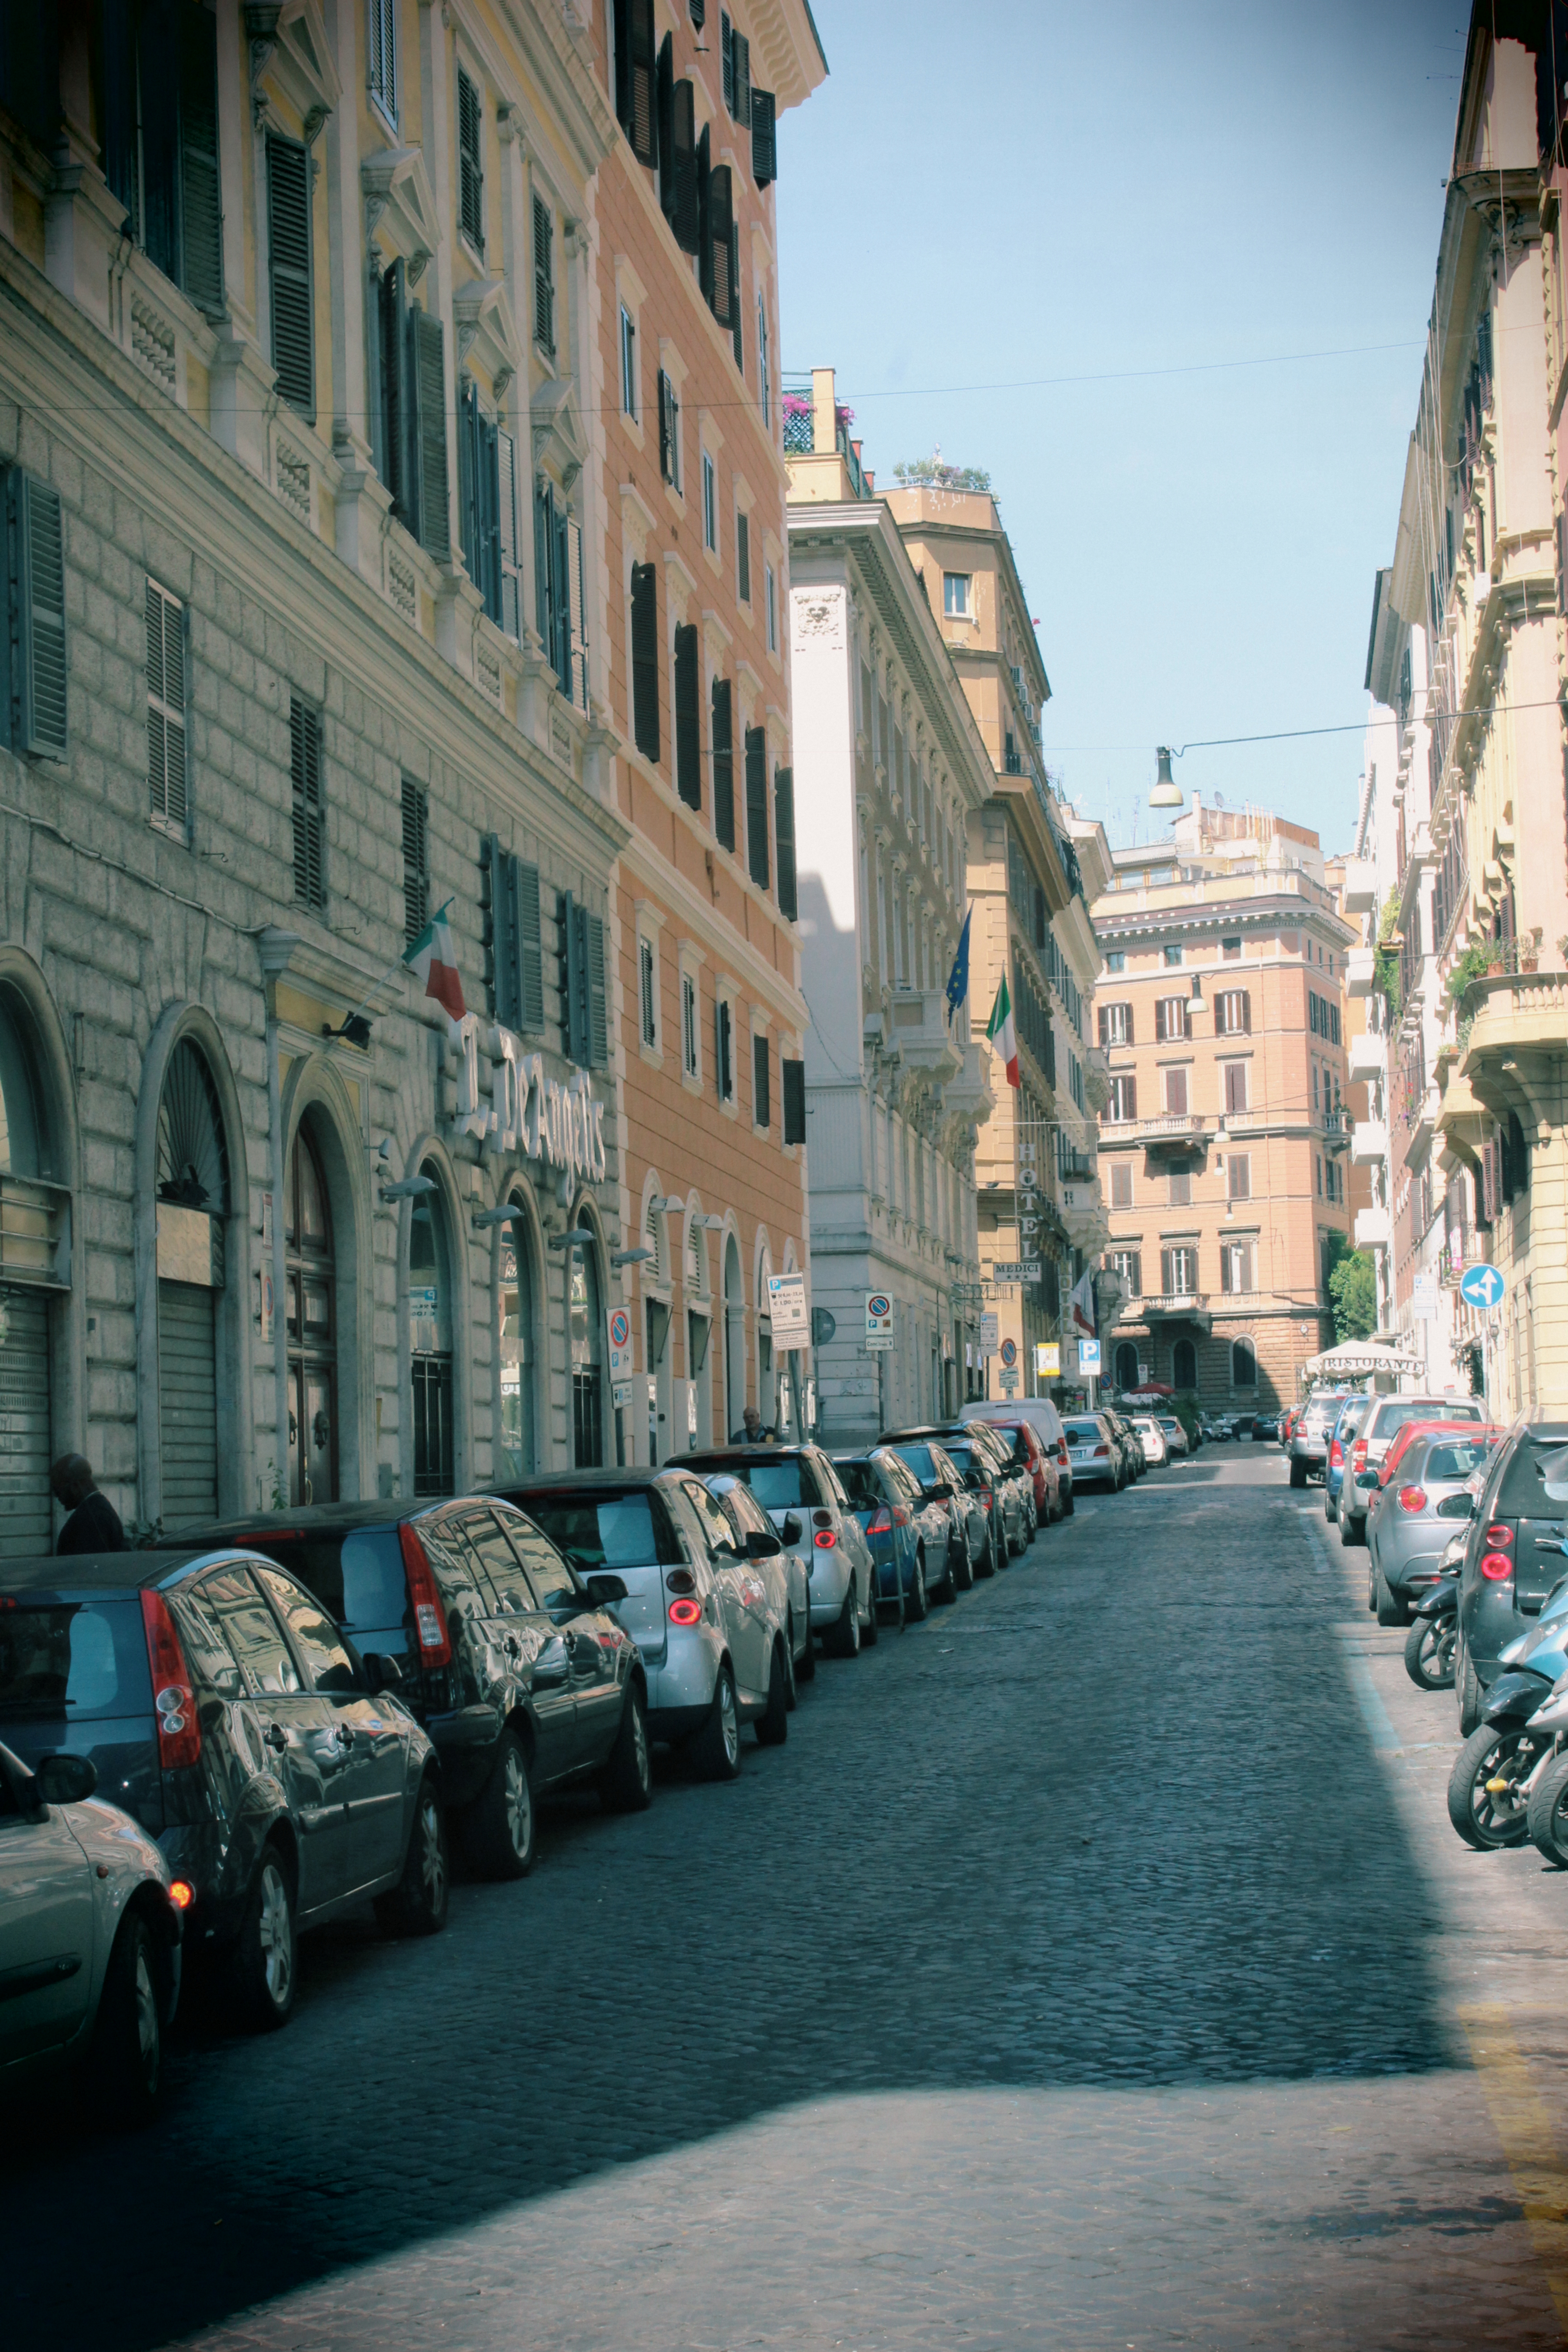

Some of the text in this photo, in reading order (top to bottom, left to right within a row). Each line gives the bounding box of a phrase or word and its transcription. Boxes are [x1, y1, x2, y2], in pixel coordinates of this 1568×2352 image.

[1018, 1143, 1039, 1259] HOTEL
[995, 1264, 1039, 1273] MEDICI
[1083, 1342, 1097, 1360] P
[1328, 1358, 1421, 1372] RISTORANTE
